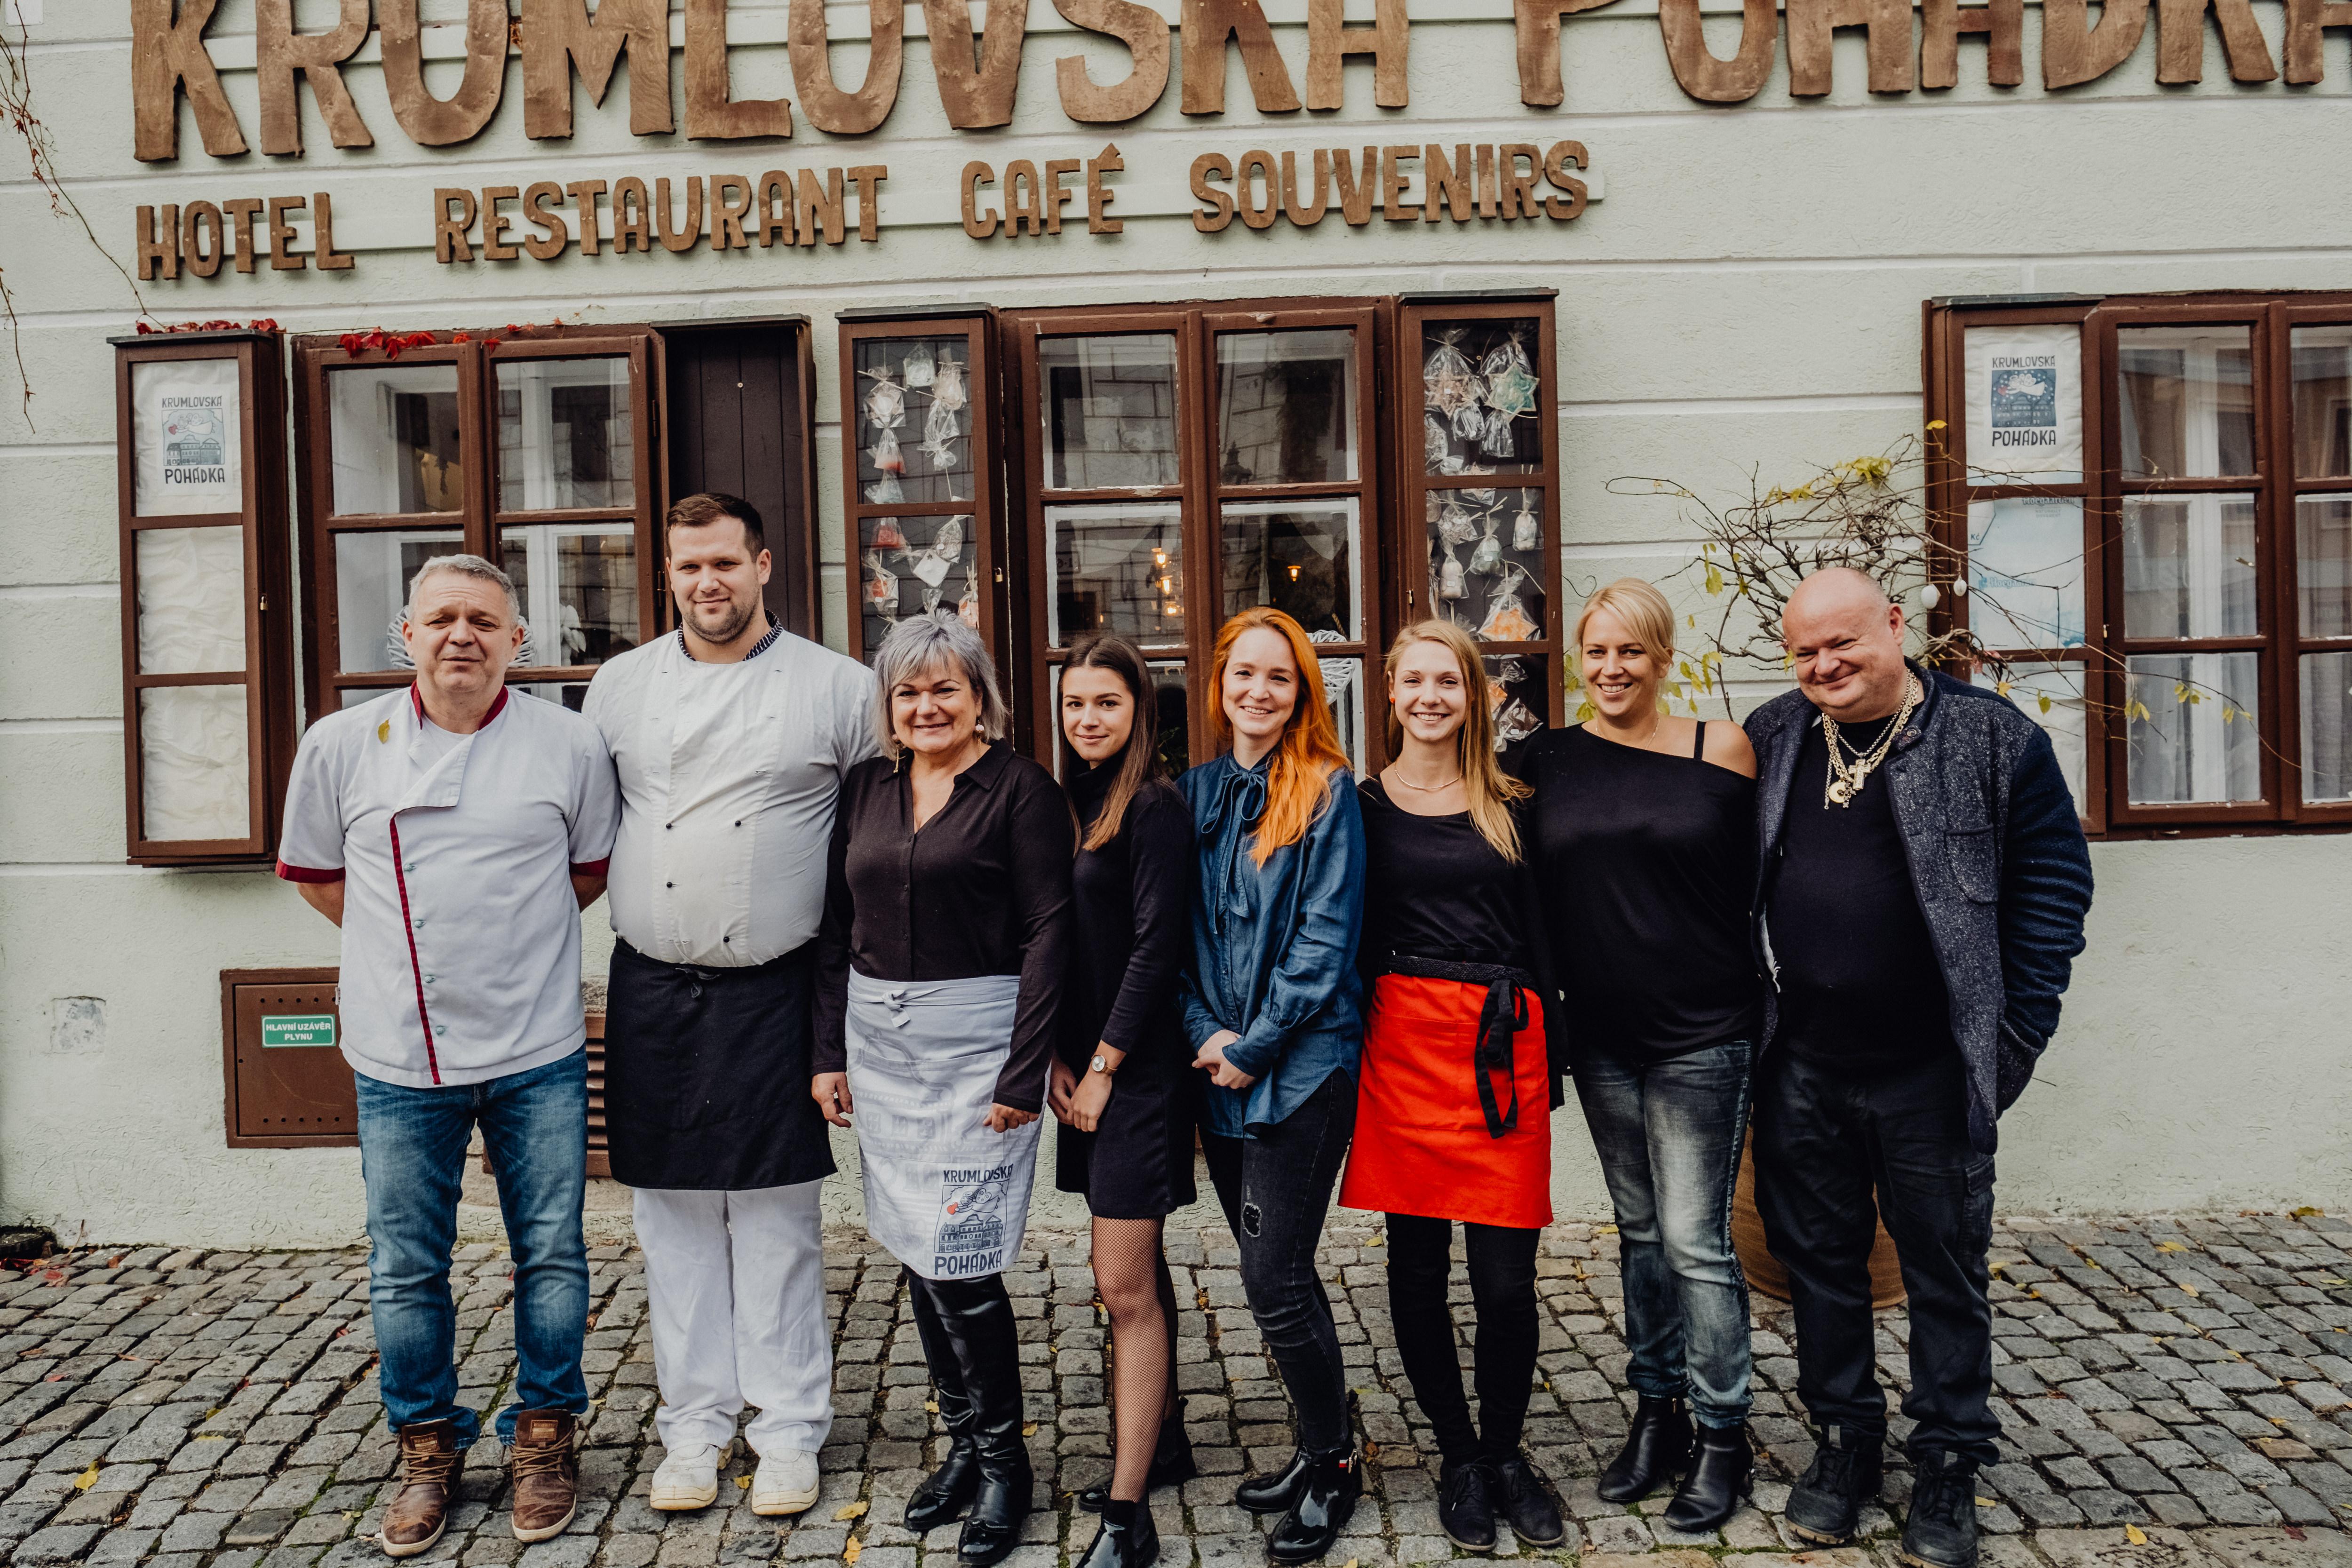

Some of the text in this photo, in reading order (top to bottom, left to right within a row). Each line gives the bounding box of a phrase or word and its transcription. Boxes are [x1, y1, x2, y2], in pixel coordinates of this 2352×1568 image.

[135, 140, 1589, 281] HOTEL RESTAURANT CAFÉ SOUVENIRS
[1992, 355, 2055, 368] KRUMLOVSKÁ
[162, 396, 222, 408] KRUMLOVSKÁ
[1992, 429, 2056, 446] POHÁDKA
[165, 467, 225, 484] POHÁDKA
[1989, 576, 2036, 589] Hoegaa
[266, 1021, 331, 1031] HLAVNÍ UZÁVĚR
[934, 1250, 1002, 1275] POHÁDKA
